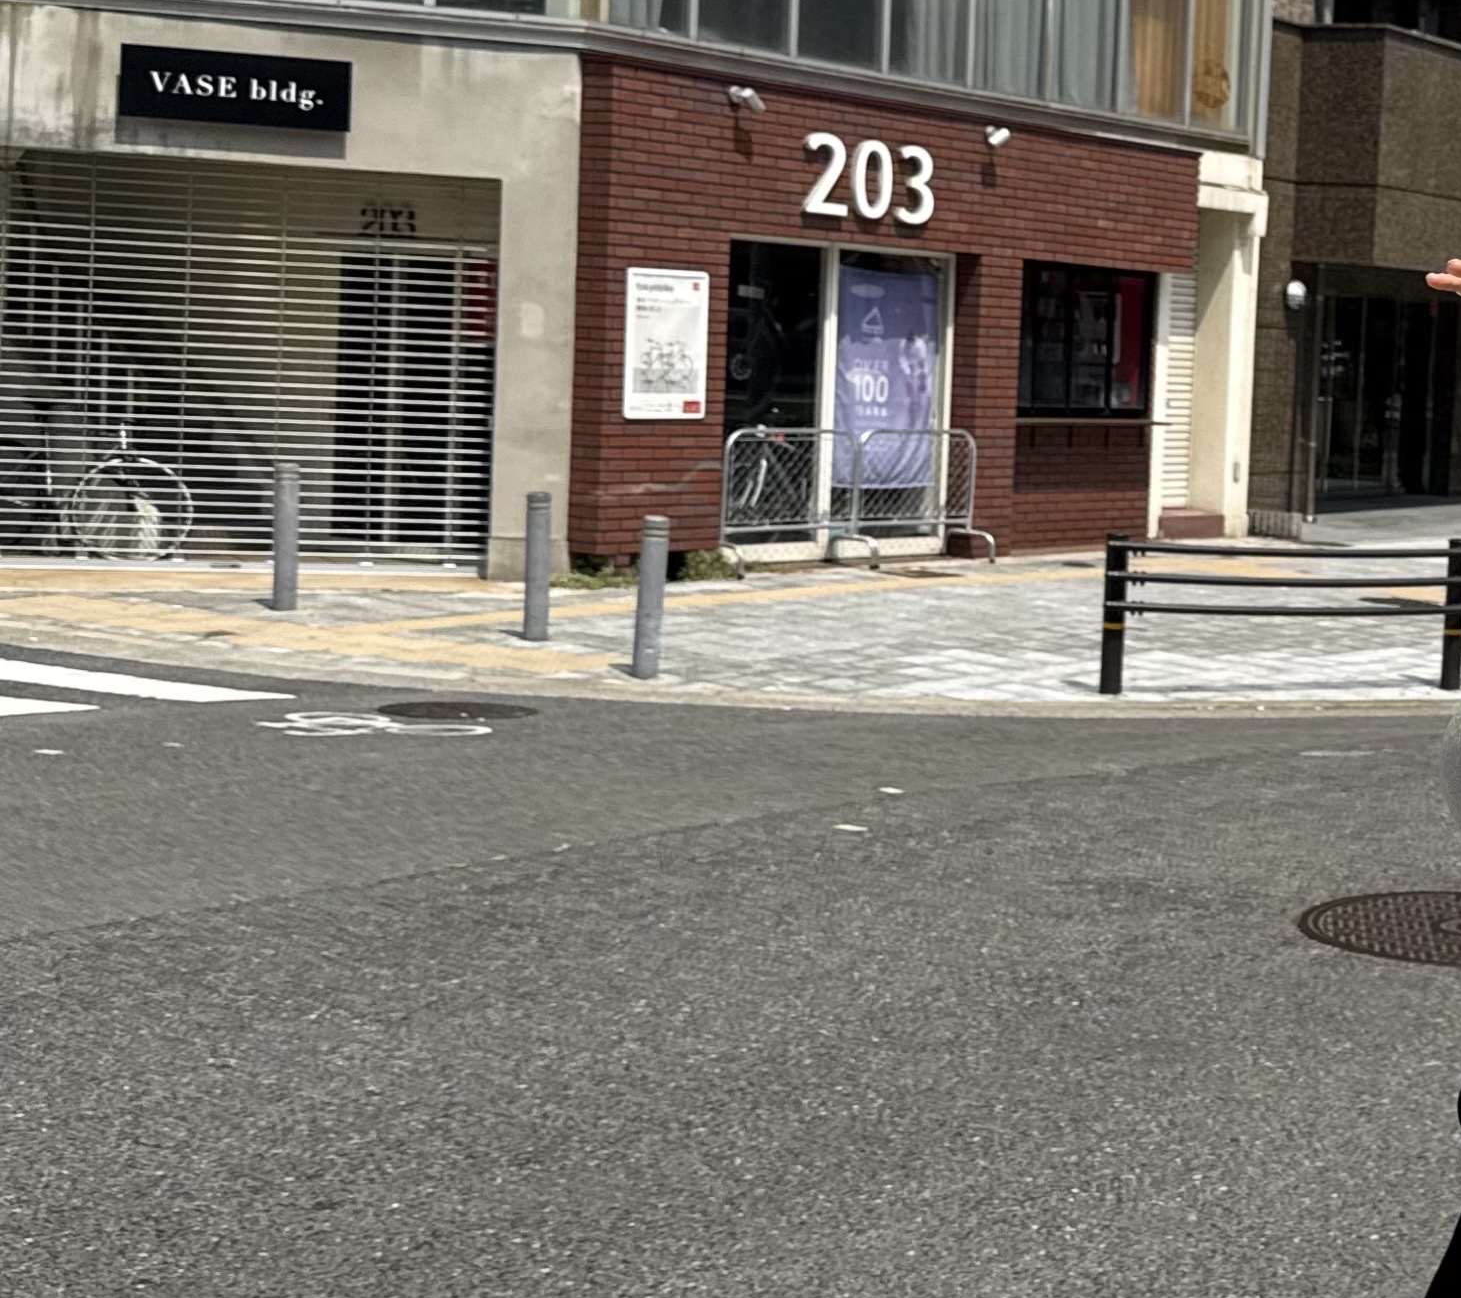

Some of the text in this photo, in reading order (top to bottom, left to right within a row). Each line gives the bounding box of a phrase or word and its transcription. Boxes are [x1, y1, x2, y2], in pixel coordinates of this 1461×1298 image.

[150, 70, 324, 111] VASE bldg.
[802, 132, 935, 225] 203
[853, 374, 889, 403] 100
